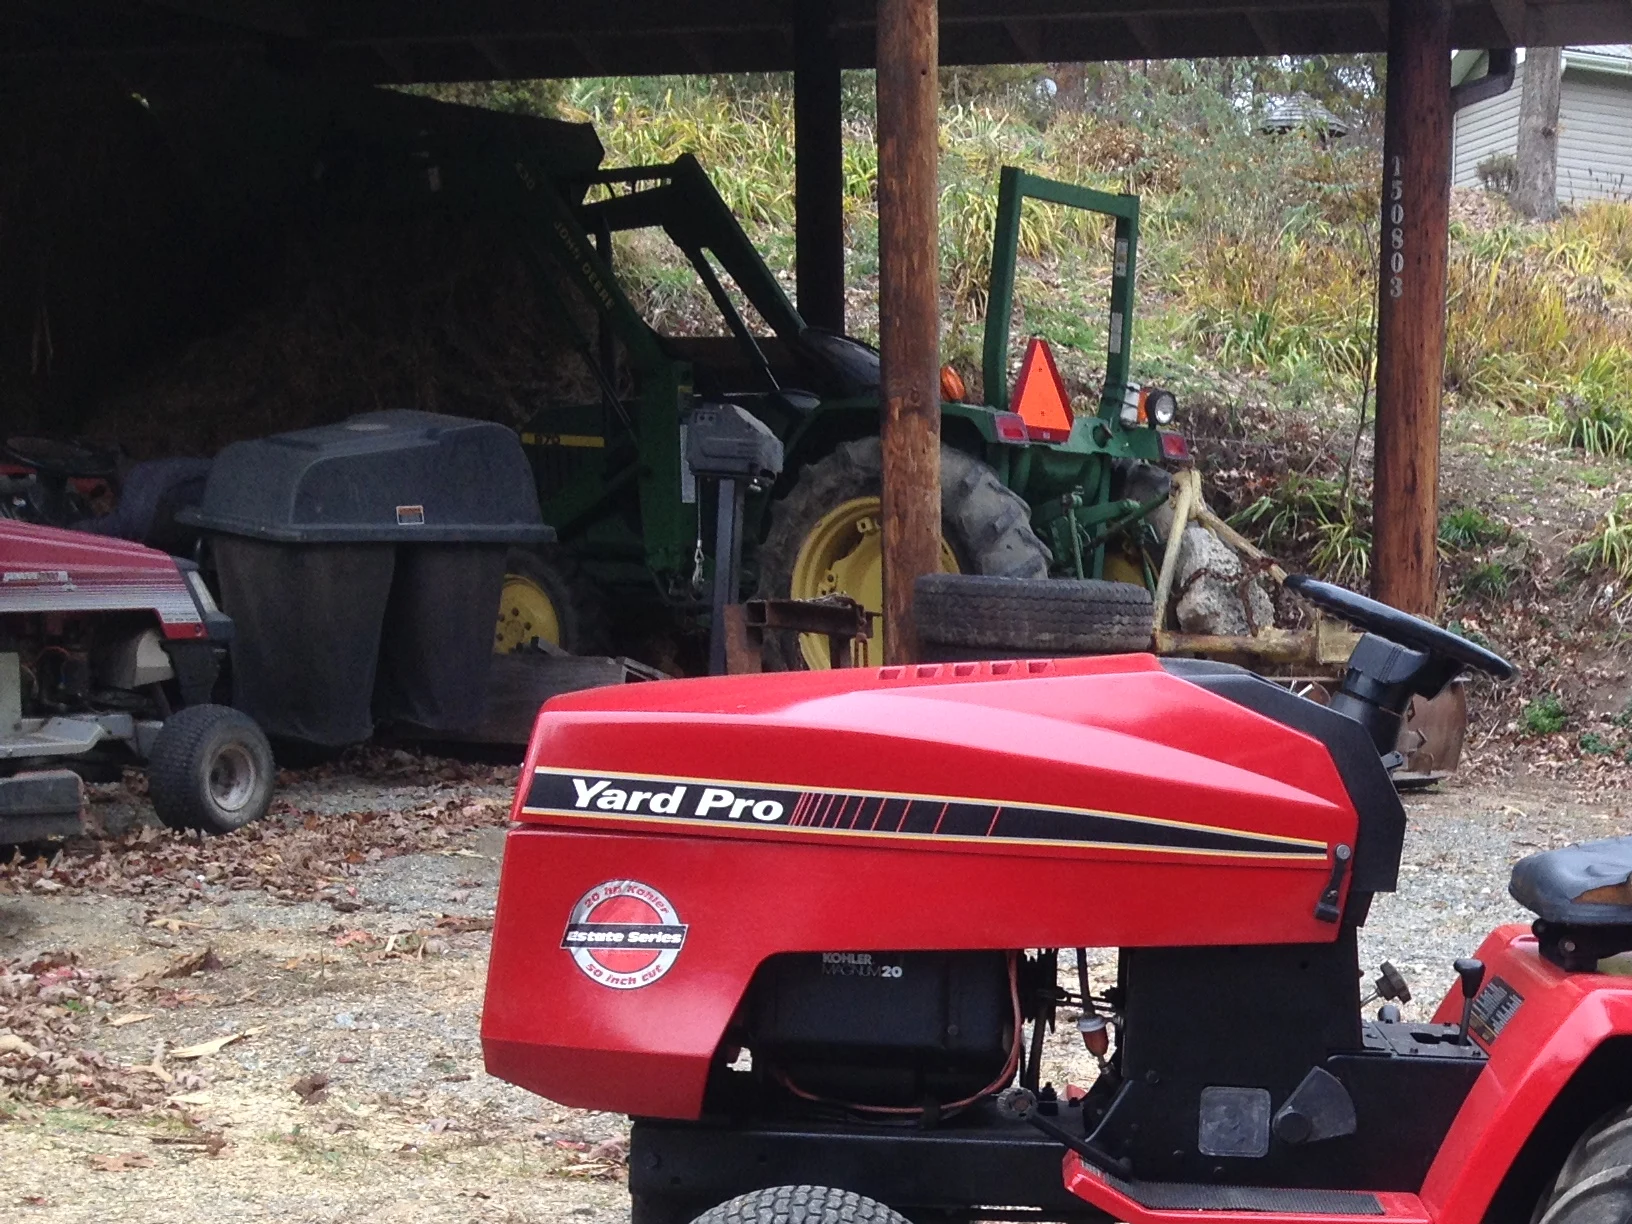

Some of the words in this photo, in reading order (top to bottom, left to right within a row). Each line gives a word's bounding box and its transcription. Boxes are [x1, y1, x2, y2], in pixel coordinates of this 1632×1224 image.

[1390, 156, 1404, 298] 150803
[582, 262, 615, 310] DEERE
[572, 779, 687, 814] Yard
[694, 788, 784, 821] Pro
[585, 893, 600, 908] 20
[627, 886, 669, 914] Kohler
[566, 931, 625, 942] Estate
[627, 931, 682, 944] Series
[822, 952, 873, 965] KOHLER
[585, 963, 604, 978] 50
[605, 974, 637, 986] inch
[641, 964, 663, 982] cut
